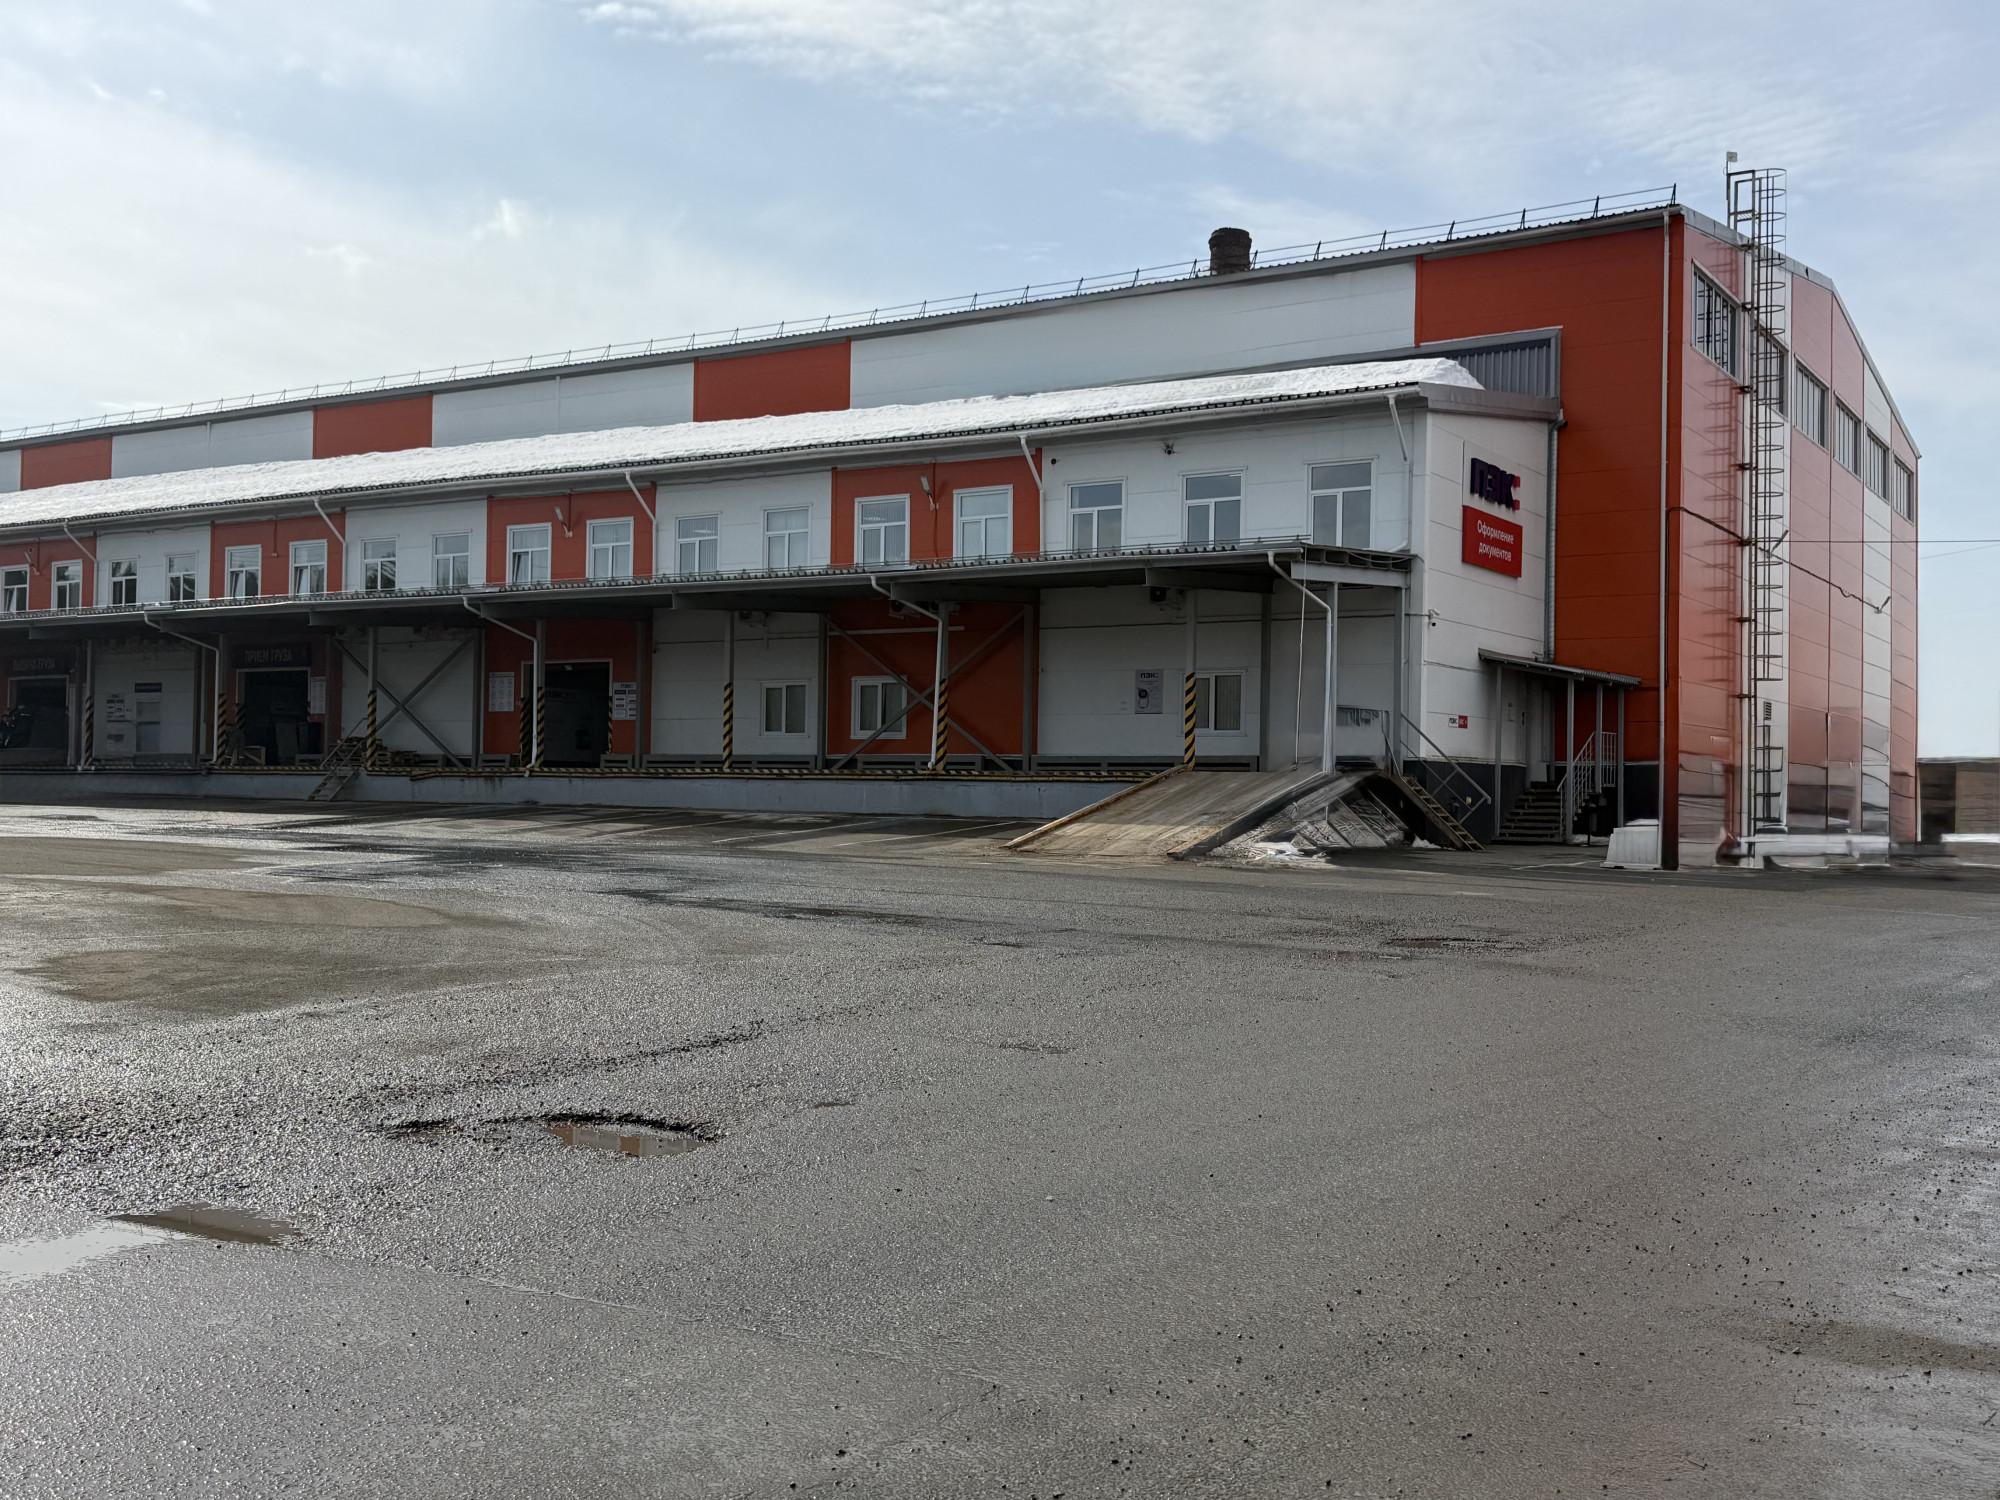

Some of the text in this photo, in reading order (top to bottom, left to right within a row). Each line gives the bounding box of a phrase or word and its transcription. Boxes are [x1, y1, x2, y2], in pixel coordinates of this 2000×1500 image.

[1470, 458, 1520, 512] ПЭК
[1477, 519, 1515, 545] Оформление
[1478, 542, 1512, 562] документов
